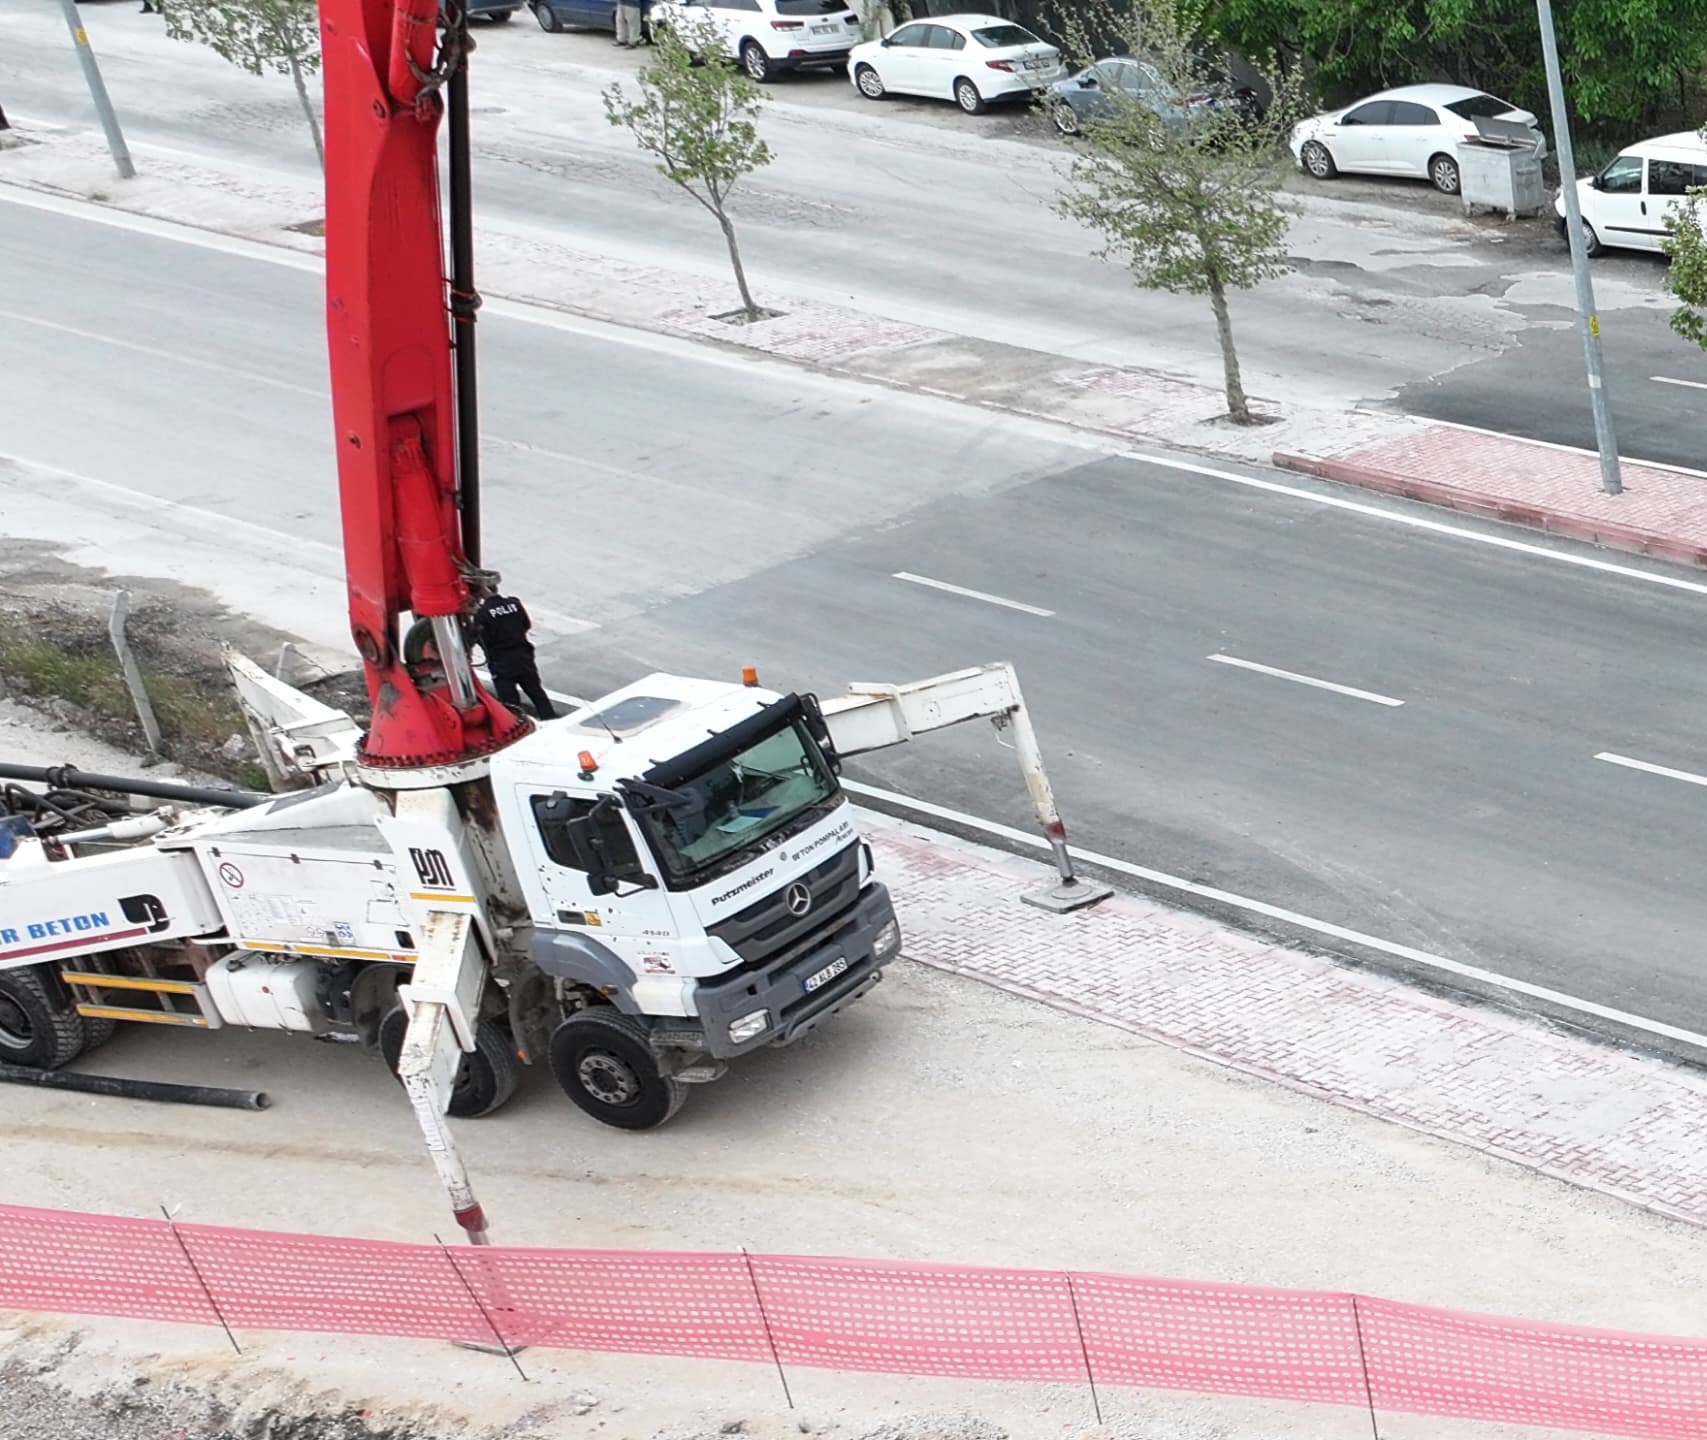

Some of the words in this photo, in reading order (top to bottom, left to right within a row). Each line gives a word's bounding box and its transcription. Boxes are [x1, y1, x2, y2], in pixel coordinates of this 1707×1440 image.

[710, 867, 776, 906] Putzmeister
[0, 929, 21, 945] R
[27, 912, 110, 940] BETON
